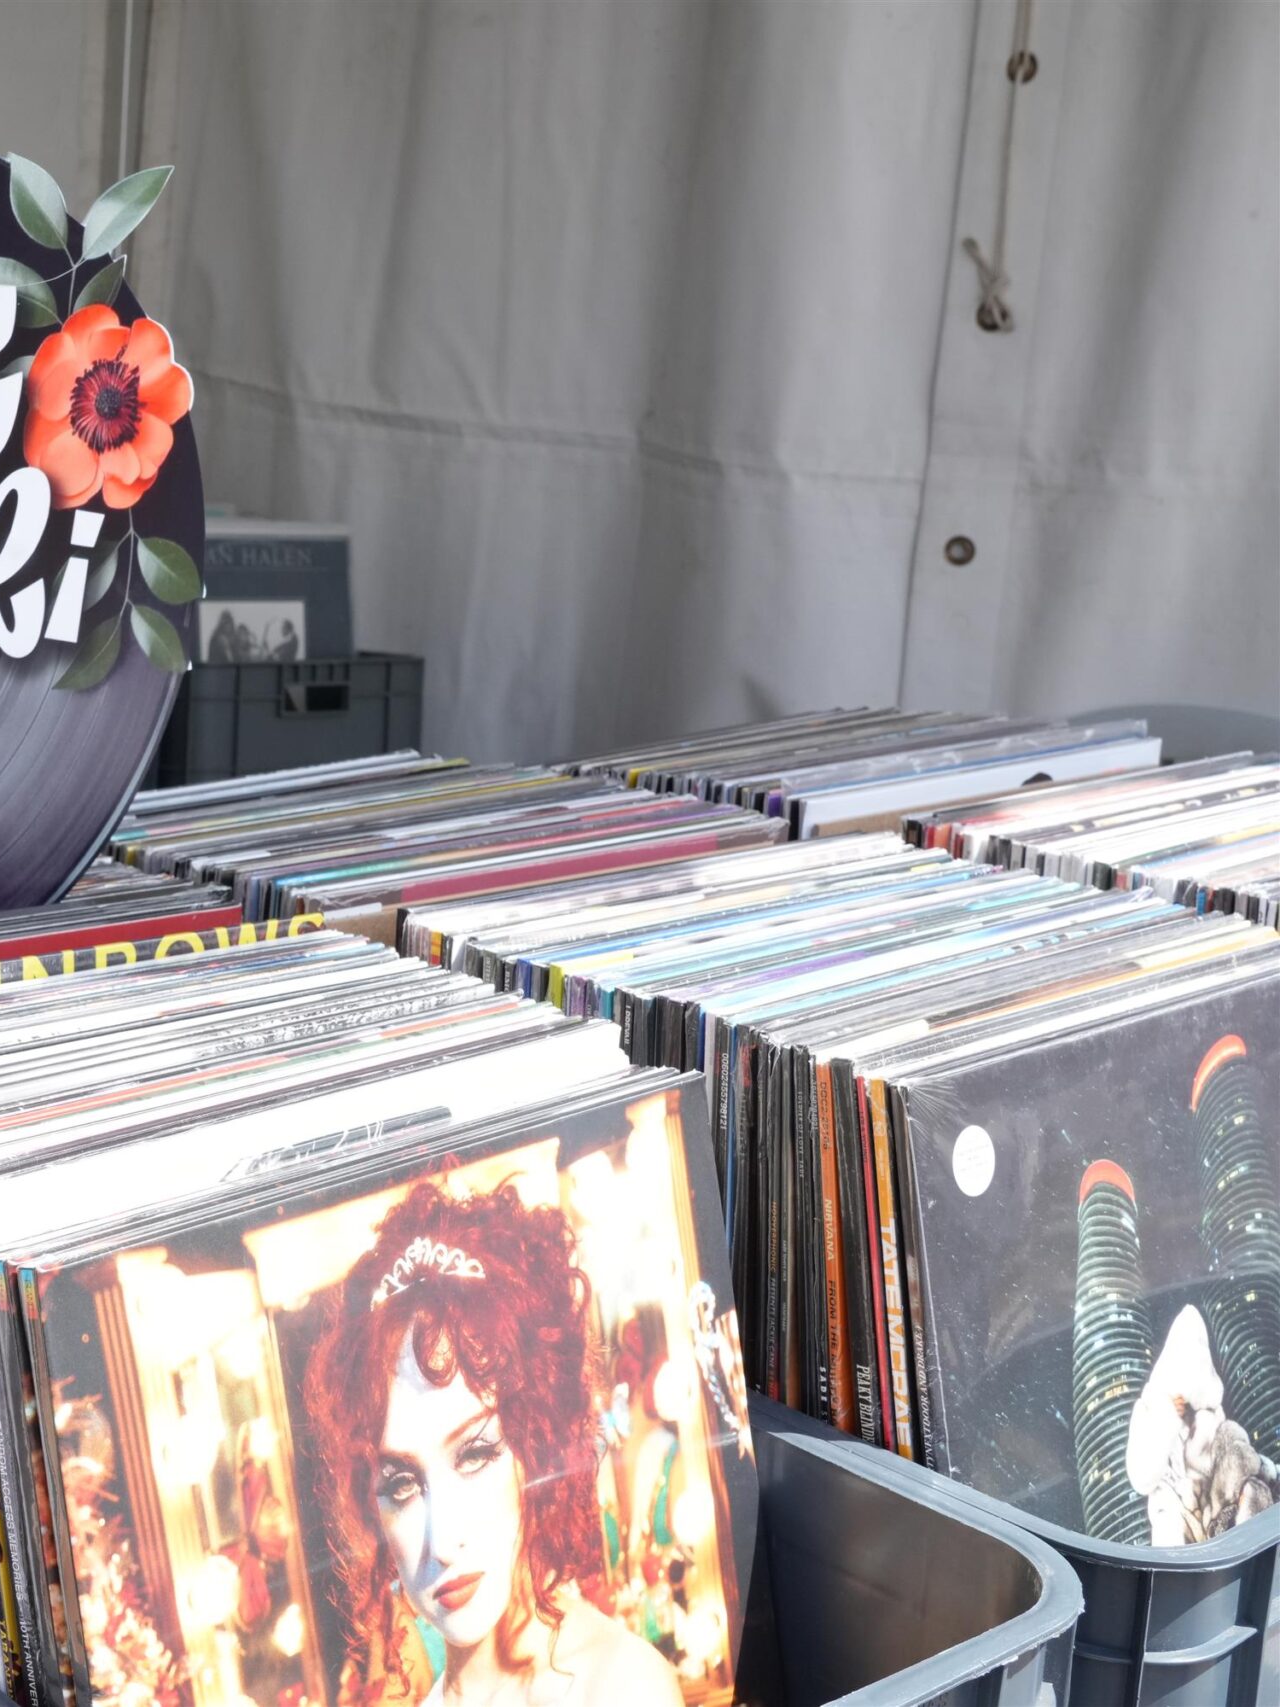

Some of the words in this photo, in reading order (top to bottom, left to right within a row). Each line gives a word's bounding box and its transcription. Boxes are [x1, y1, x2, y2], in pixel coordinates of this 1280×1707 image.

[242, 547, 313, 568] HALEN
[720, 1053, 729, 1130] 00602455798121
[769, 1200, 777, 1272] HOOVERPHONIC
[825, 1199, 835, 1260] NIRVANA
[881, 1218, 902, 1311] TATE
[828, 1280, 837, 1320] FROM
[830, 1325, 839, 1348] THE
[820, 1367, 828, 1402] SADE
[856, 1364, 872, 1403] PEAKY
[887, 1312, 911, 1446] MCRAE
[918, 1367, 929, 1393] AND
[921, 1391, 935, 1470] TYNEXTDOOR
[2, 1479, 14, 1525] ACCESS
[7, 1526, 25, 1601] MEMORIES
